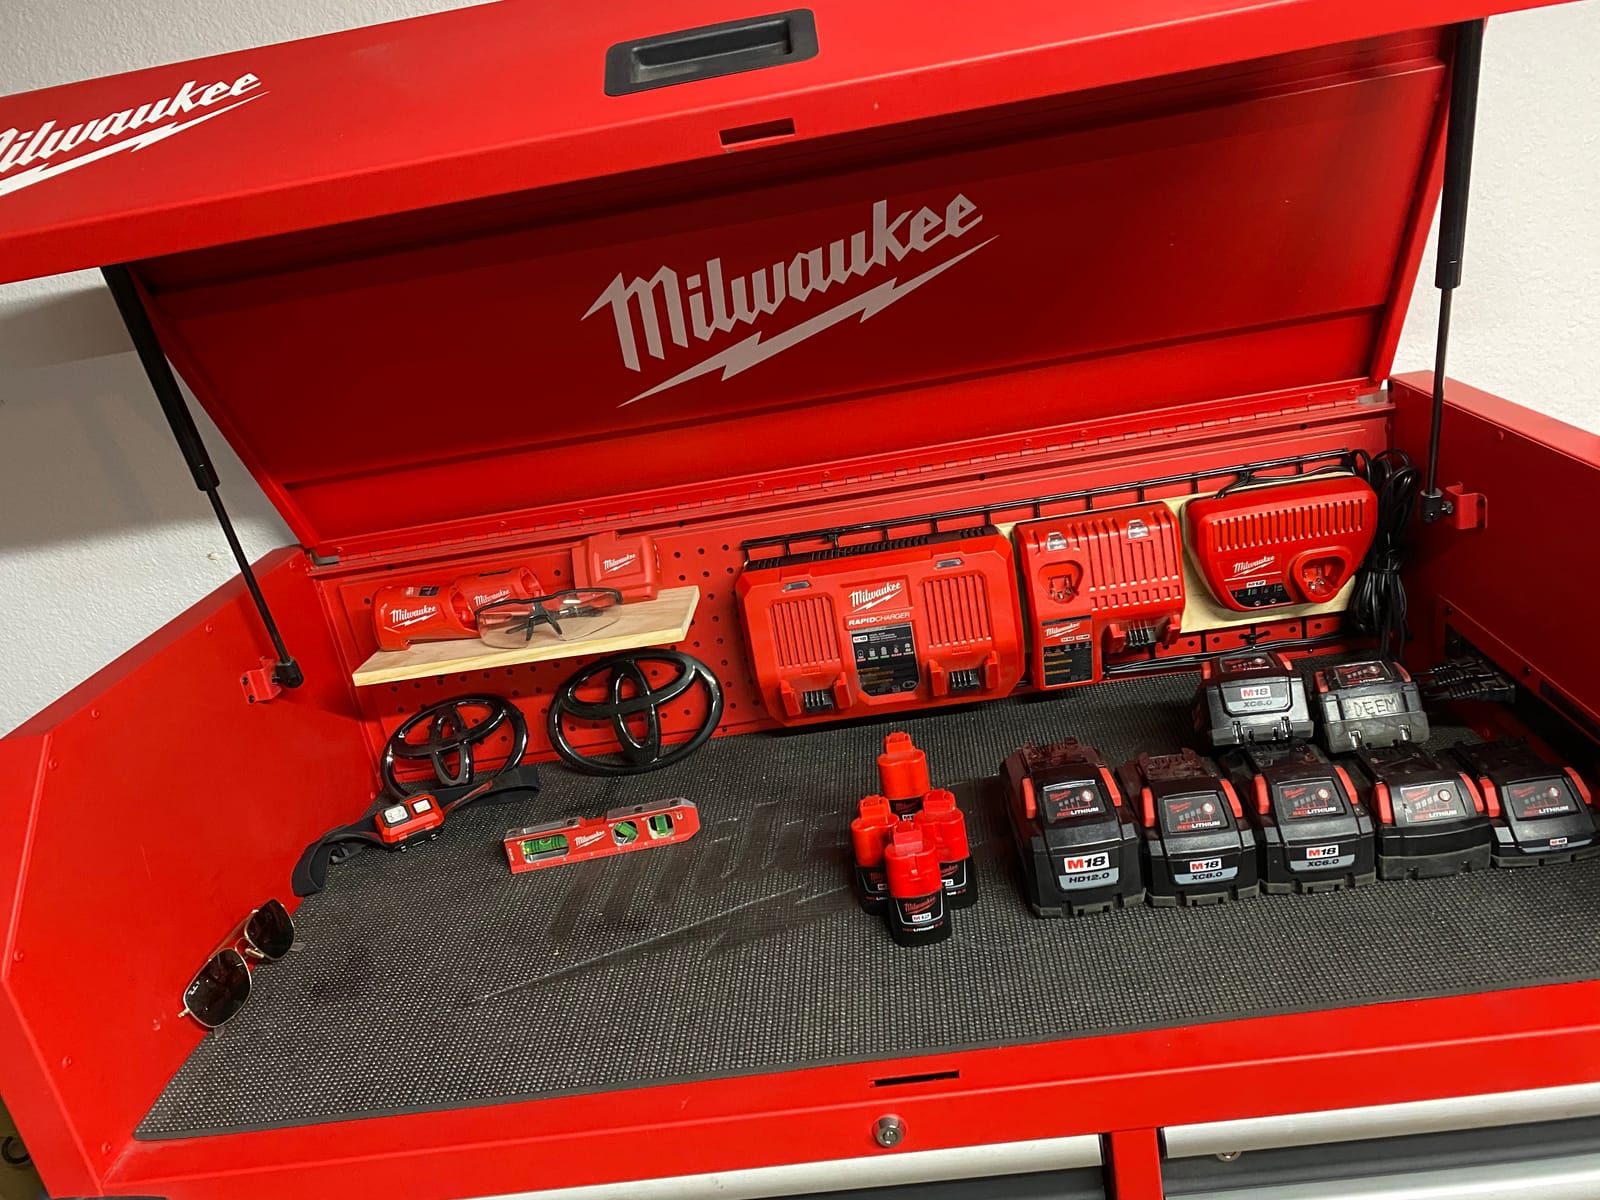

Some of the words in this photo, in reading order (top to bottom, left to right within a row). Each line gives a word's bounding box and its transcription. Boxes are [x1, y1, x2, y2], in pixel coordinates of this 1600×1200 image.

[0, 73, 261, 173] ilwaukee
[580, 193, 983, 372] Milwaukee
[848, 582, 901, 608] Milwaukee
[389, 605, 436, 623] Milwaukee
[1242, 688, 1269, 697] M18
[1308, 847, 1337, 857] M18
[1067, 856, 1106, 870] M18
[1191, 860, 1220, 870] M18
[1069, 872, 1110, 883] HD12.0
